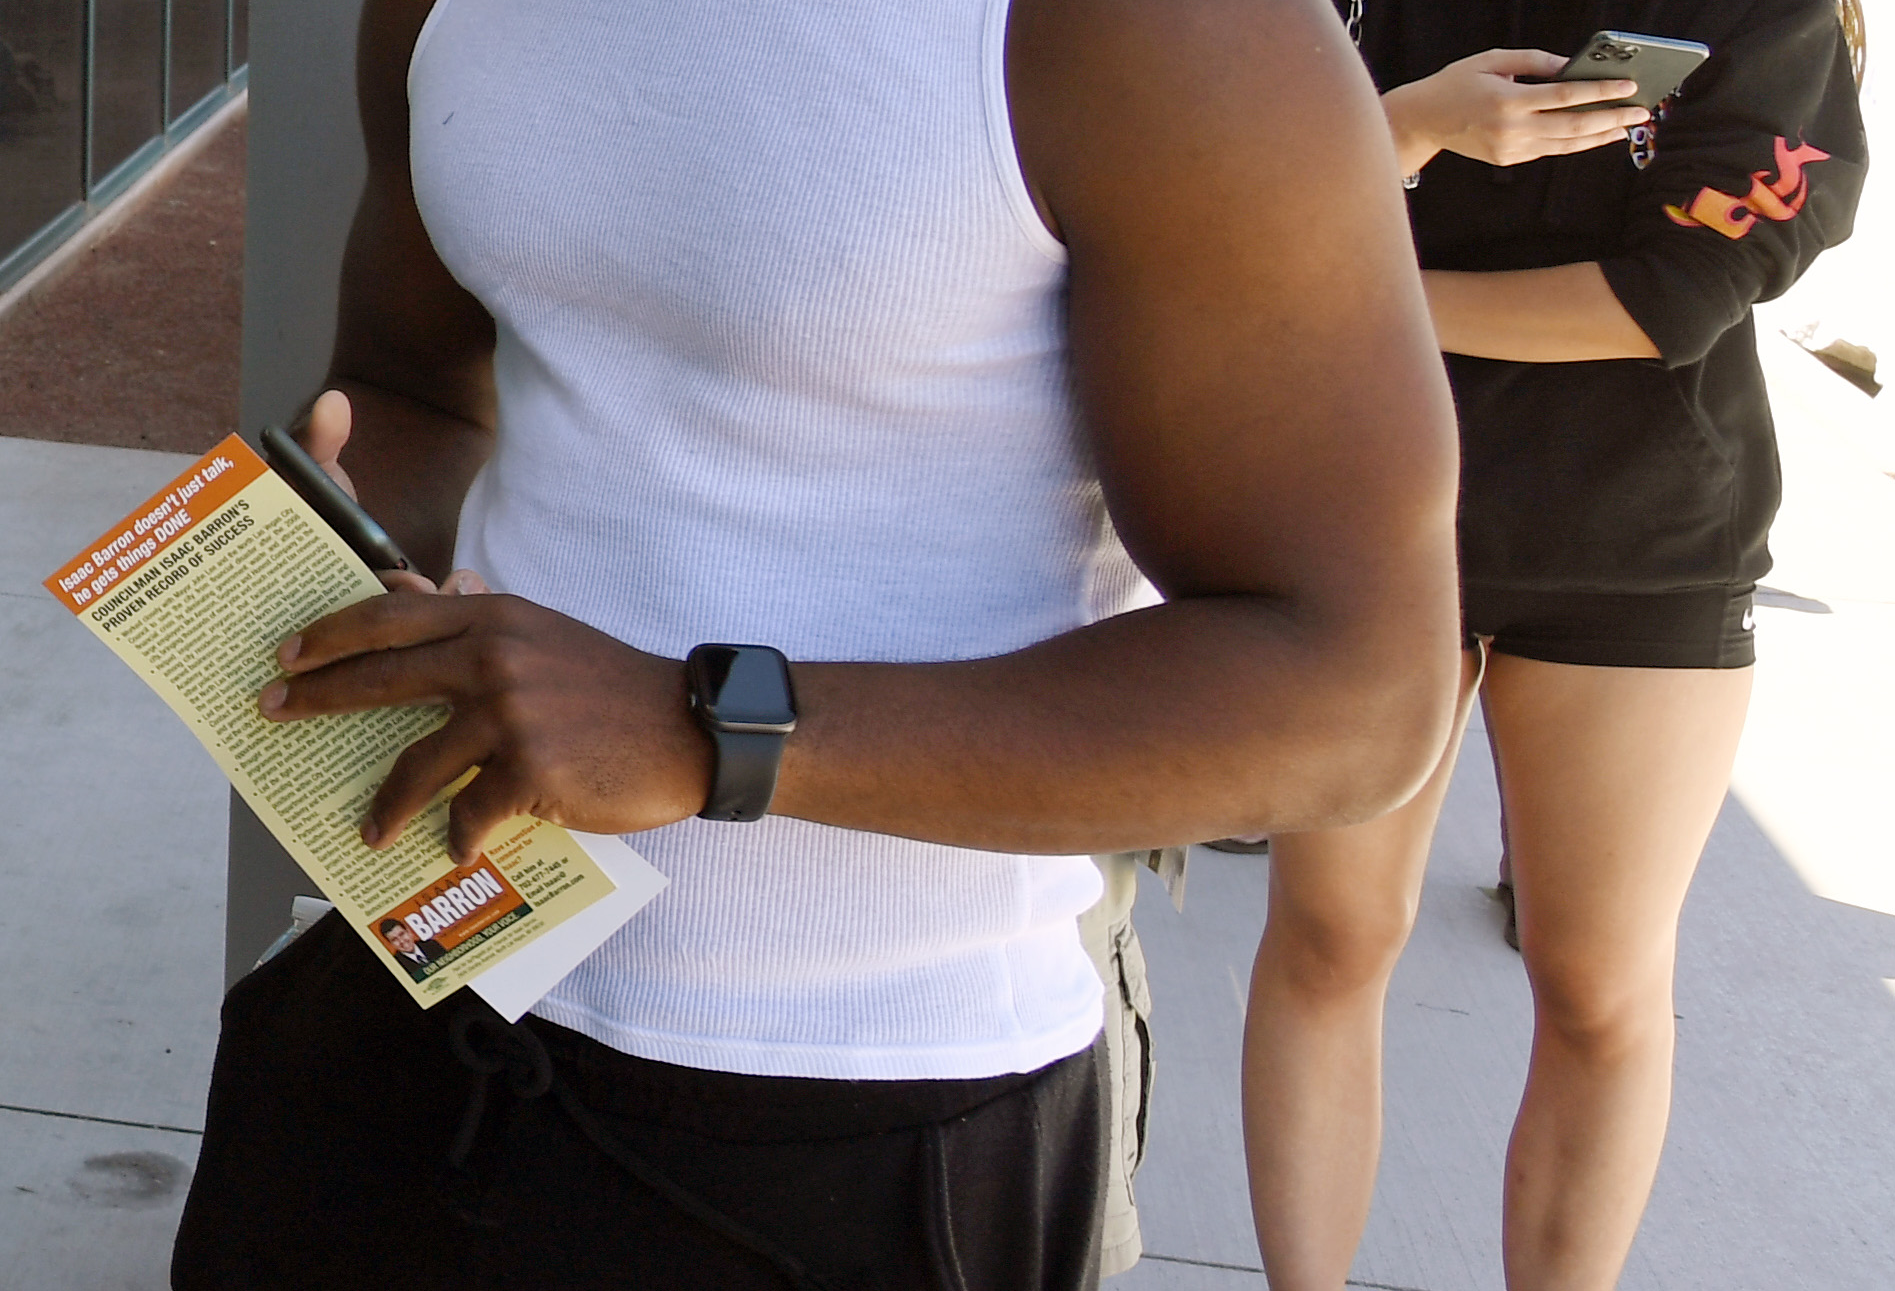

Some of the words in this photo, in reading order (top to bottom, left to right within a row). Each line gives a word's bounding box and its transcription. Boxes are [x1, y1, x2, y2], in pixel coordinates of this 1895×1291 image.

[57, 560, 94, 592] Isaac
[91, 529, 135, 567] Barron
[132, 493, 180, 535] doesn't
[175, 474, 205, 505] just
[201, 455, 234, 482] talk,
[71, 586, 93, 605] he
[89, 565, 120, 595] gets
[115, 536, 158, 572] things
[153, 508, 192, 543] DONE
[91, 566, 161, 621] COUNCILMAN
[158, 541, 195, 570] ISAAC
[192, 499, 249, 545] BARRON'S
[101, 596, 147, 632] PROVEN
[144, 564, 189, 600] RECORD
[187, 551, 204, 568] OF
[203, 515, 255, 556] SUCCESS
[405, 869, 502, 940] BARRON
[510, 870, 525, 882] Call
[522, 864, 537, 874] him
[536, 858, 545, 867] at
[422, 962, 439, 977] OUR
[435, 933, 485, 967] NEIGHBORHOOD,
[481, 922, 501, 937] YOUR
[496, 911, 520, 927] VOICE.
